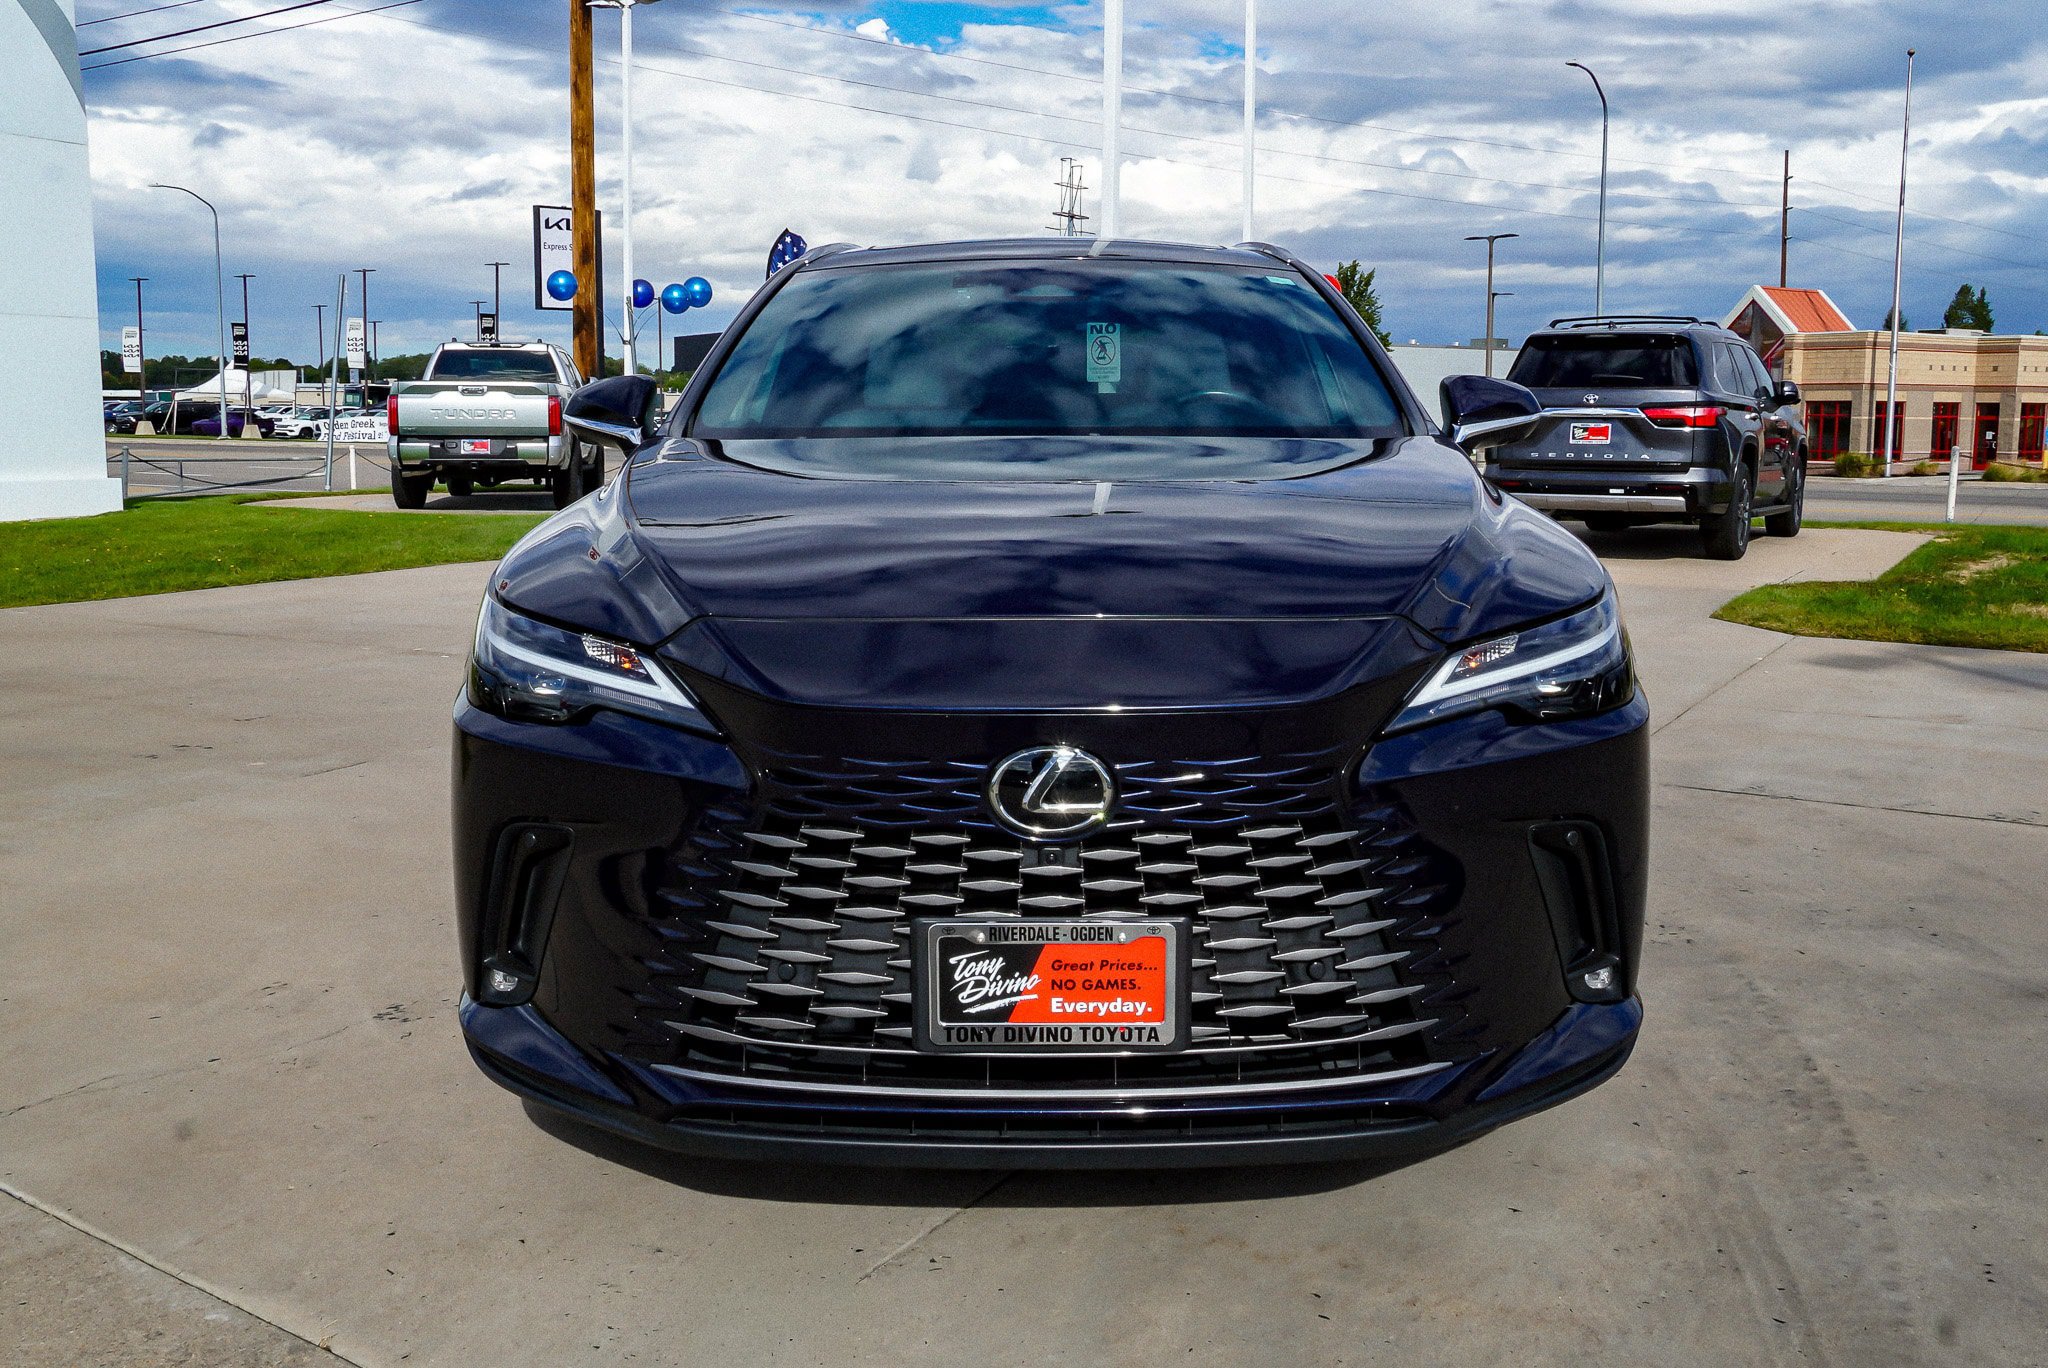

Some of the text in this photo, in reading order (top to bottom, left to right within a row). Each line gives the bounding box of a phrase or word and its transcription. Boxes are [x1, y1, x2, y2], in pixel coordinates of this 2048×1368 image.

[544, 217, 572, 231] KI
[543, 241, 568, 252] Express
[1090, 322, 1117, 335] NO
[429, 408, 517, 420] TUNDRA
[323, 420, 349, 431] Oden
[350, 419, 376, 429] Greek
[343, 430, 376, 441] Festival
[1530, 452, 1650, 460] SEQUOIA
[989, 926, 1060, 942] RIVERDALE
[1070, 926, 1114, 942] OGDEN
[949, 950, 1006, 982] Tony
[1051, 959, 1158, 971] Great Prices...
[950, 972, 1042, 1004] Divino
[1051, 979, 1142, 991] NO GAMES.
[1051, 997, 1153, 1017] Everyday.
[944, 1026, 1160, 1043] TONY DIVINO TOYOTA
